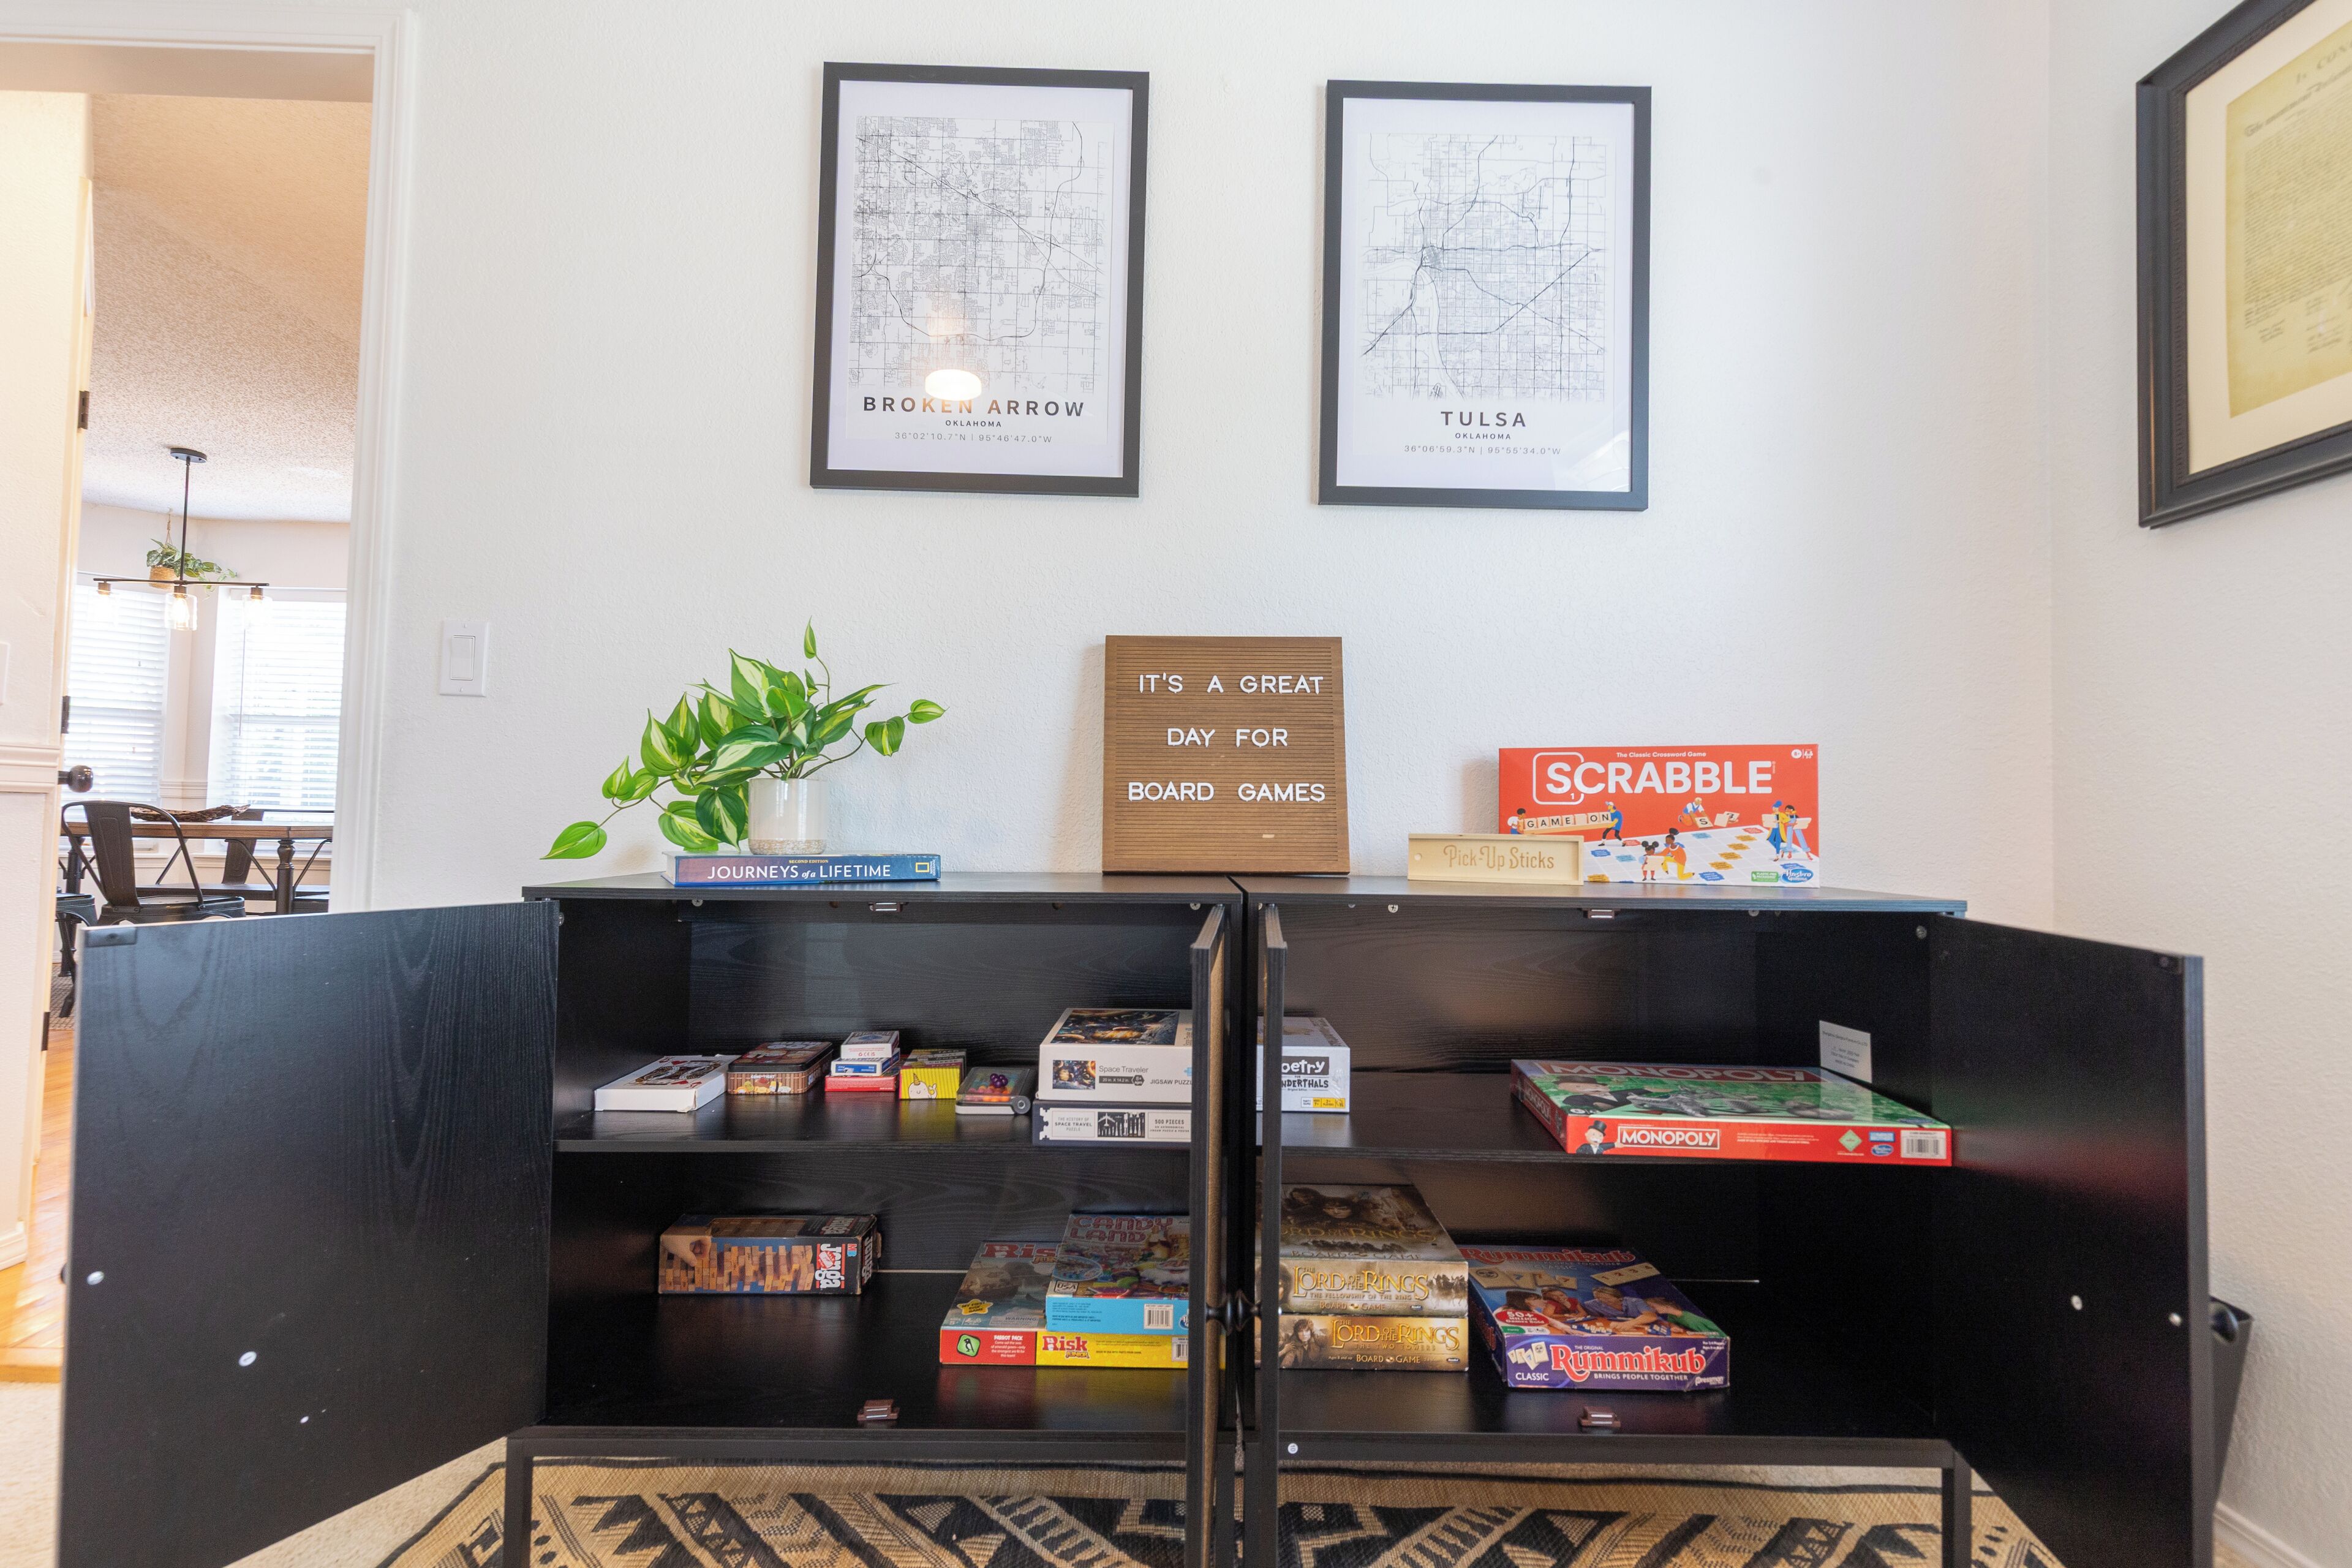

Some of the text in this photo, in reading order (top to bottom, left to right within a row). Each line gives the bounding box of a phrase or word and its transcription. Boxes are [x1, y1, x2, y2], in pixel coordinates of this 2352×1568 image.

[863, 396, 1084, 417] BROKEN ARROW
[1441, 411, 1526, 428] TULSA
[1138, 672, 1324, 695] IT'S A GREAT
[1167, 727, 1288, 747] DAY FOR
[1545, 760, 1773, 794] SCRABBLE
[1128, 781, 1326, 802] BOARD GAMES
[1527, 813, 1610, 828] GAME ON
[1443, 844, 1554, 871] Pick-Up Sticks
[707, 864, 799, 880] JOURNEYS
[801, 869, 810, 880] of
[820, 864, 891, 878] LIFETIME
[1785, 869, 1812, 877] Hasbro
[1282, 1060, 1325, 1074] oetry
[1549, 1065, 1806, 1082] MONOPOLY
[1282, 1079, 1329, 1088] NDERTHALS
[1623, 1129, 1716, 1147] MONOPOLY
[1072, 1216, 1174, 1231] CANDY
[1281, 1227, 1325, 1236] ORD
[1070, 1229, 1148, 1243] LAND
[847, 1243, 858, 1257] MB
[981, 1243, 1057, 1258] Ris
[1459, 1248, 1636, 1265] Rummikub
[815, 1243, 845, 1289] Jenga
[1292, 1266, 1346, 1297] LORD
[1361, 1270, 1429, 1300] RINGS
[1320, 1301, 1346, 1310] BOARD
[1332, 1319, 1381, 1349] LORD
[1396, 1324, 1460, 1351] RINGS
[1042, 1336, 1088, 1351] Risk
[1356, 1354, 1384, 1363] BOARD
[1550, 1344, 1706, 1382] Rummikub
[1515, 1372, 1550, 1381] CLASSIC
